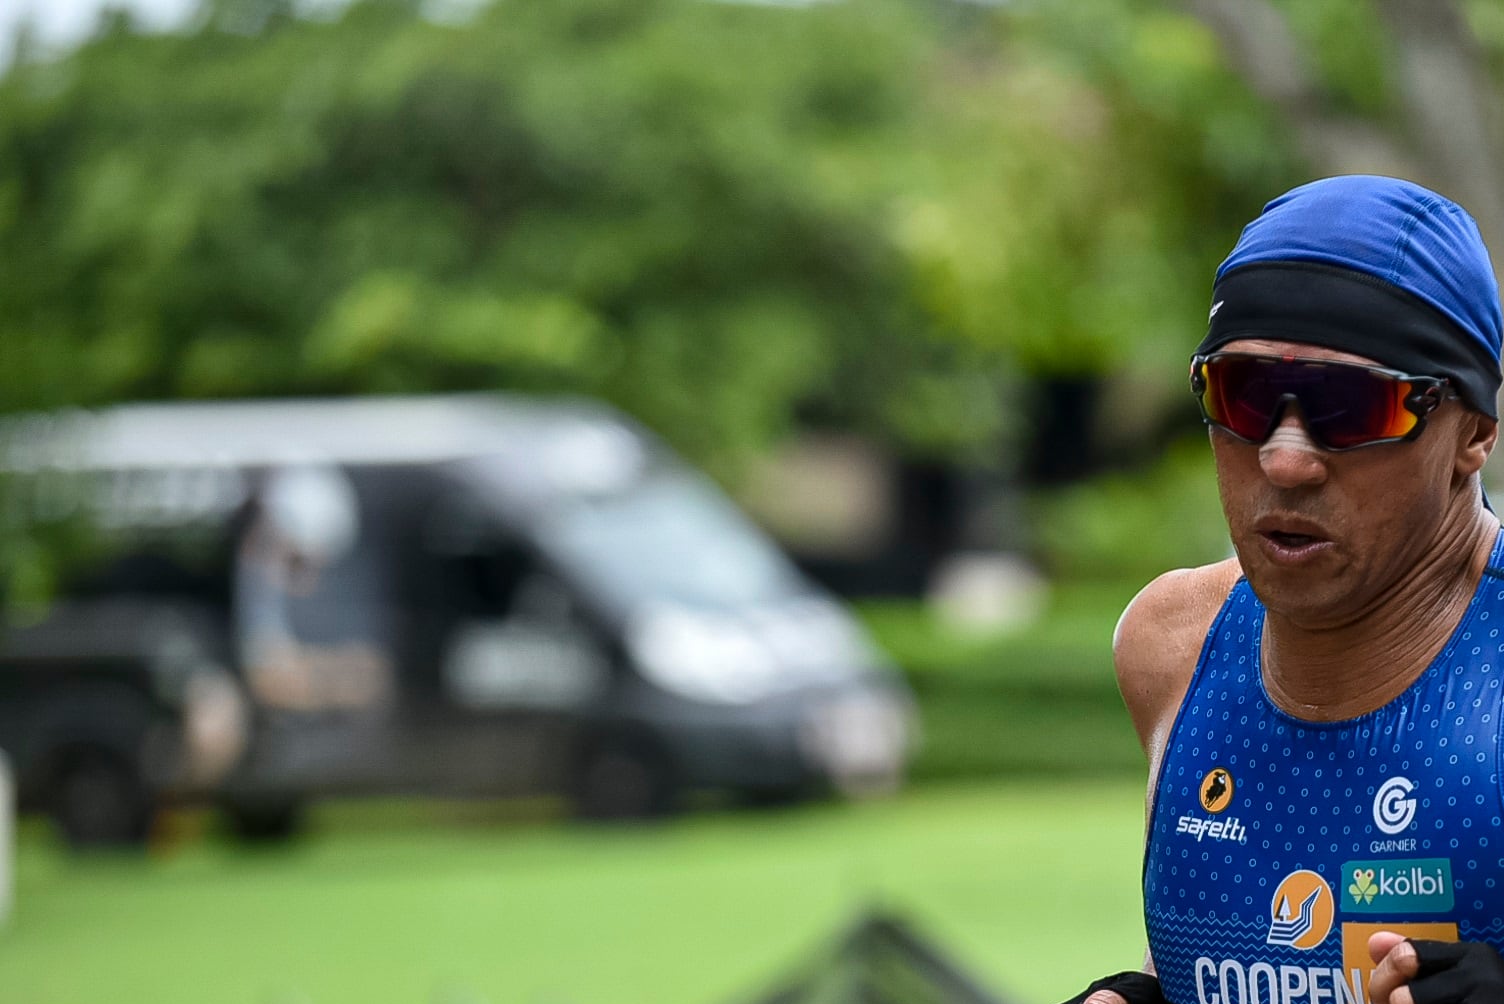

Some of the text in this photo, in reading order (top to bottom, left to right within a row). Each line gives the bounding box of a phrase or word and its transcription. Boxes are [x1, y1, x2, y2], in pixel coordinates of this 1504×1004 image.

[1176, 816, 1246, 842] safetti
[1370, 839, 1416, 853] GARNIER
[1380, 867, 1443, 895] kölbi
